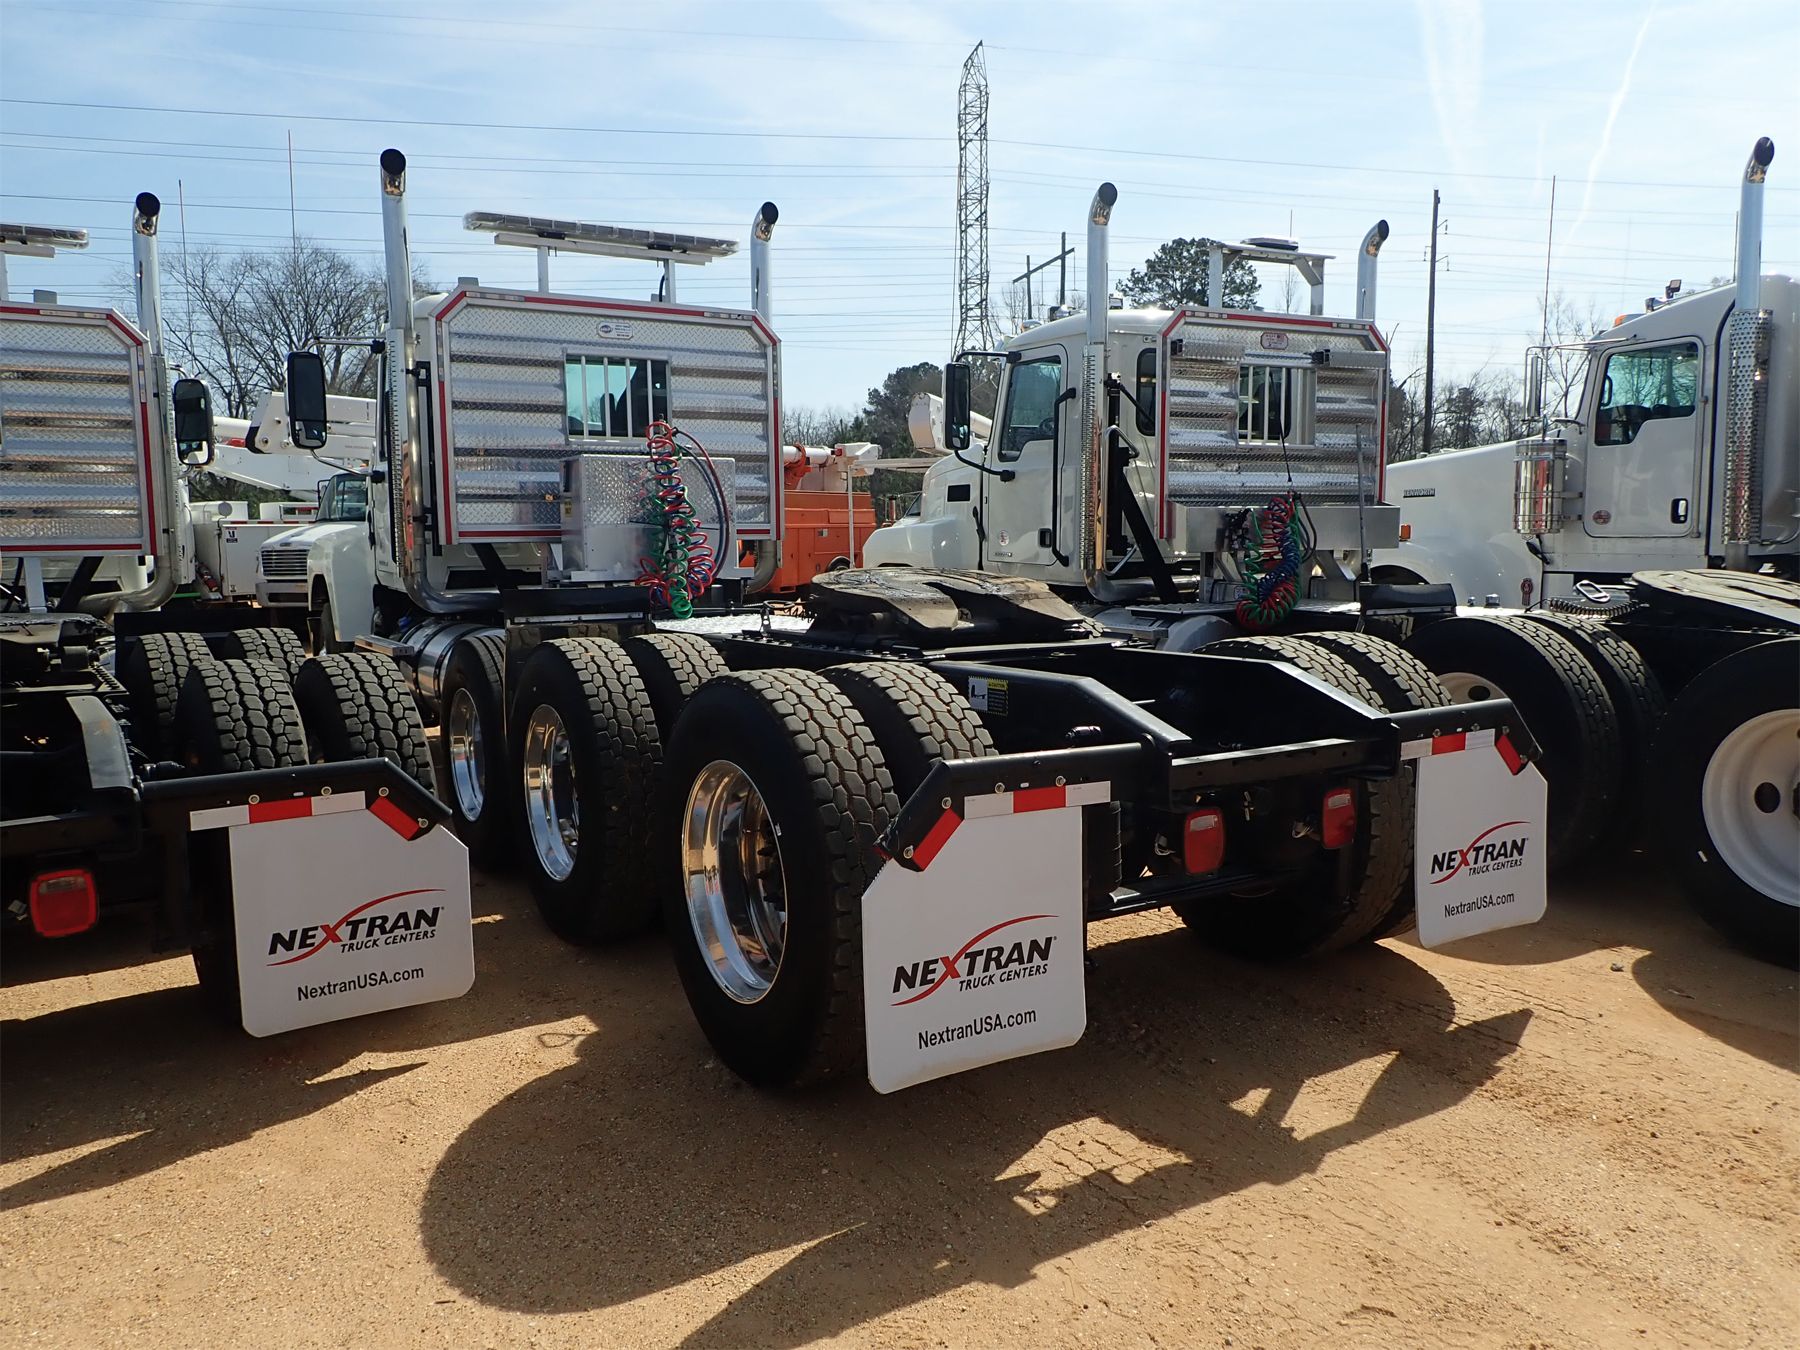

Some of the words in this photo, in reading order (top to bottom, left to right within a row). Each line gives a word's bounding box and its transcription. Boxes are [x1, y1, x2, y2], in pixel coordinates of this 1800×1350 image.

[1430, 837, 1526, 875] NEXTRAN
[1468, 864, 1490, 877] TRUCK
[1492, 858, 1523, 871] CENTERS
[1444, 892, 1515, 918] NextranUSA.com
[268, 906, 441, 956] NEXTRAN
[340, 936, 380, 954] TRUCK
[384, 929, 437, 946] CENTERS
[892, 936, 1053, 993] NEXTRAN
[958, 974, 995, 992] TRUCK
[999, 963, 1048, 982] CENTERS
[297, 967, 425, 1001] NextranUSA.com
[918, 1009, 1037, 1049] NextranUSA.com
